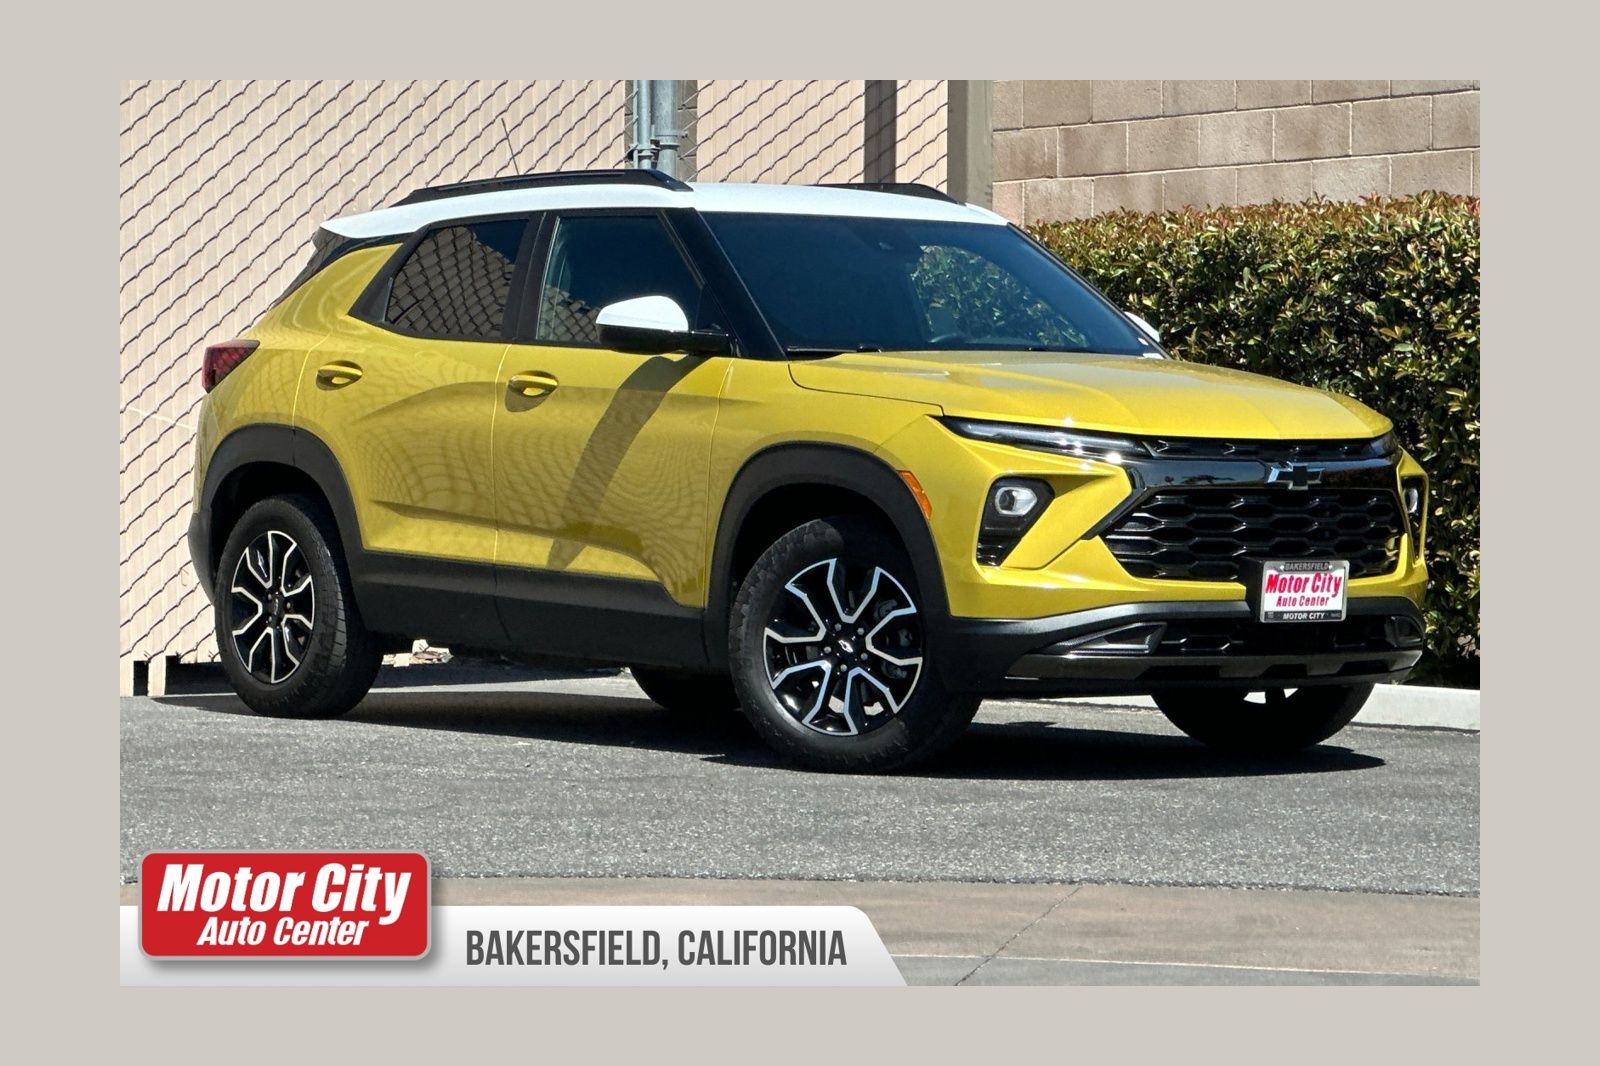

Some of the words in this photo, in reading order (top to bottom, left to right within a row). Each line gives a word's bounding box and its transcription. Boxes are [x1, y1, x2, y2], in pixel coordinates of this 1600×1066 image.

[1285, 562, 1329, 570] BAKERSFIELD
[1265, 574, 1310, 593] Motor
[1311, 572, 1342, 598] City
[1276, 596, 1297, 607] Auto
[1299, 596, 1329, 607] Center
[1283, 612, 1307, 620] MOTOR
[1309, 612, 1325, 620] CITY
